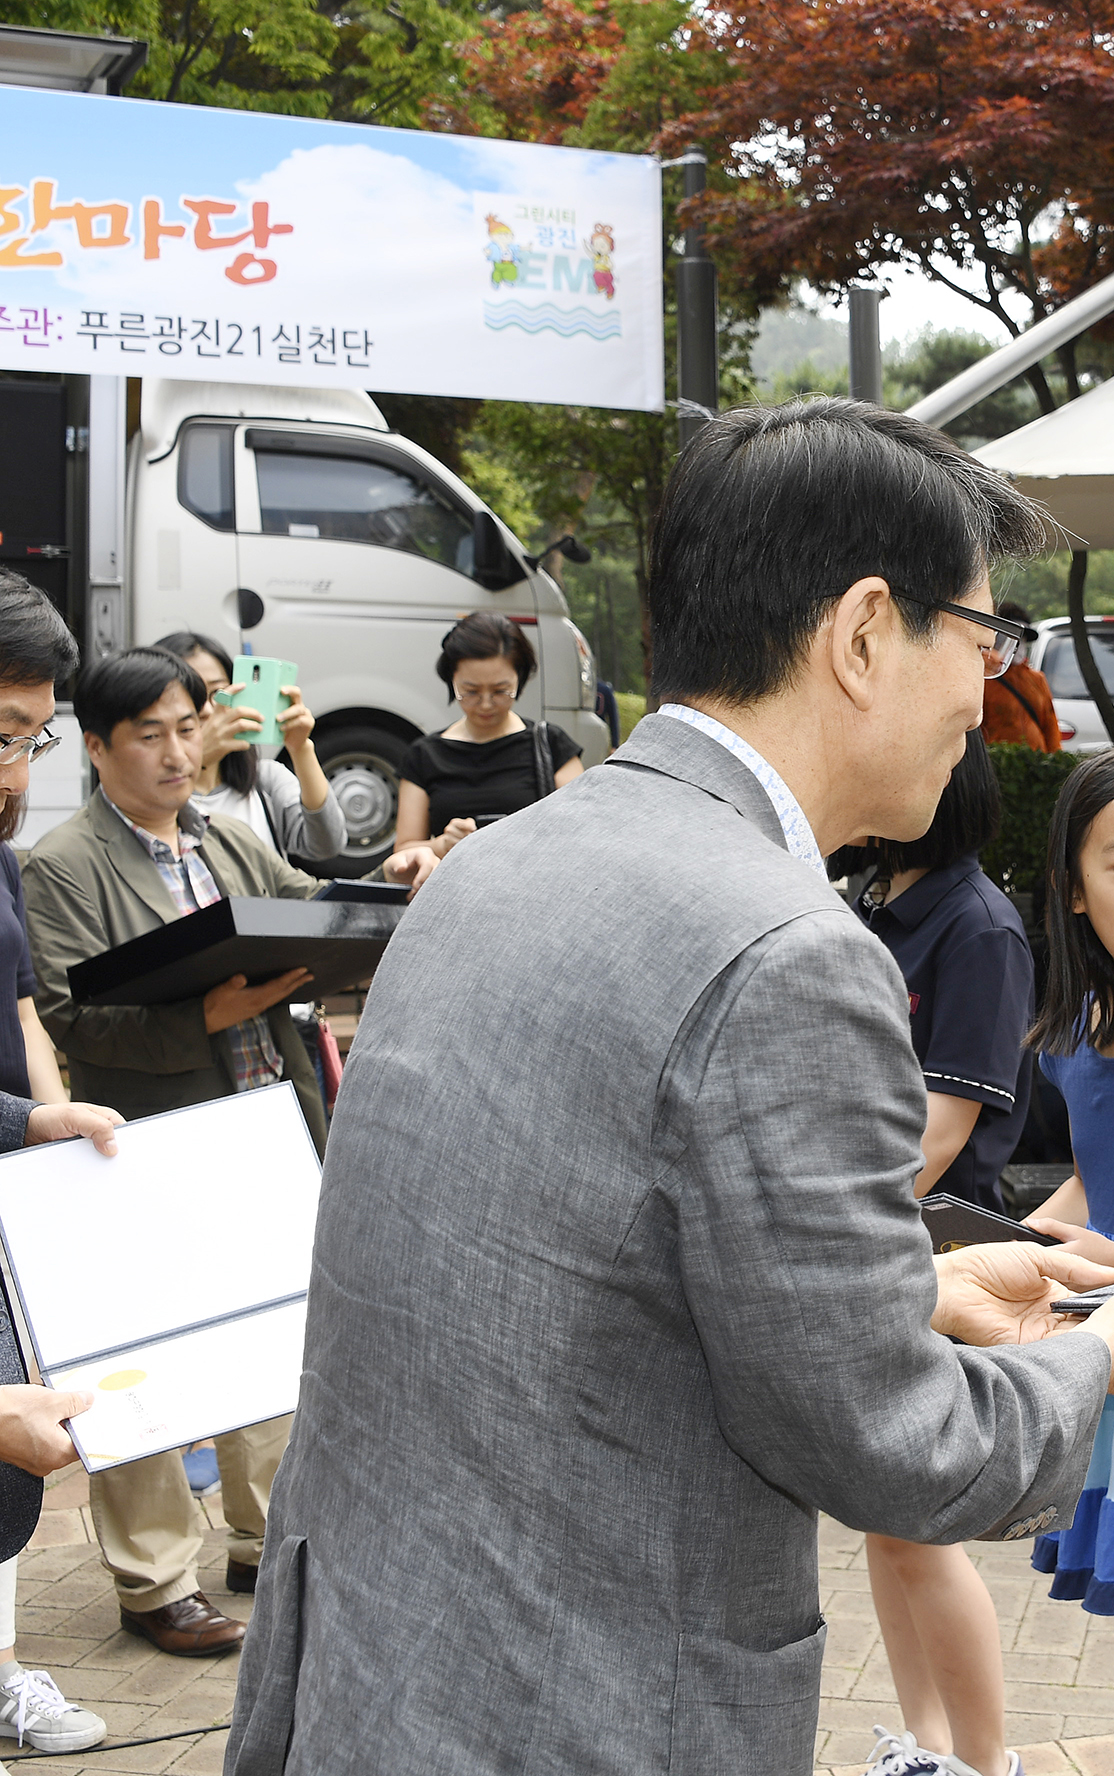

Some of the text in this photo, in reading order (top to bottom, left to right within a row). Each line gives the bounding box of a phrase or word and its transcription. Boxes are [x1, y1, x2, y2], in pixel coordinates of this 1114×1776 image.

[514, 204, 577, 225] 그린시티
[536, 225, 577, 250] 광진
[516, 252, 598, 295] EM
[77, 310, 373, 367] 푸른광진21실천단
